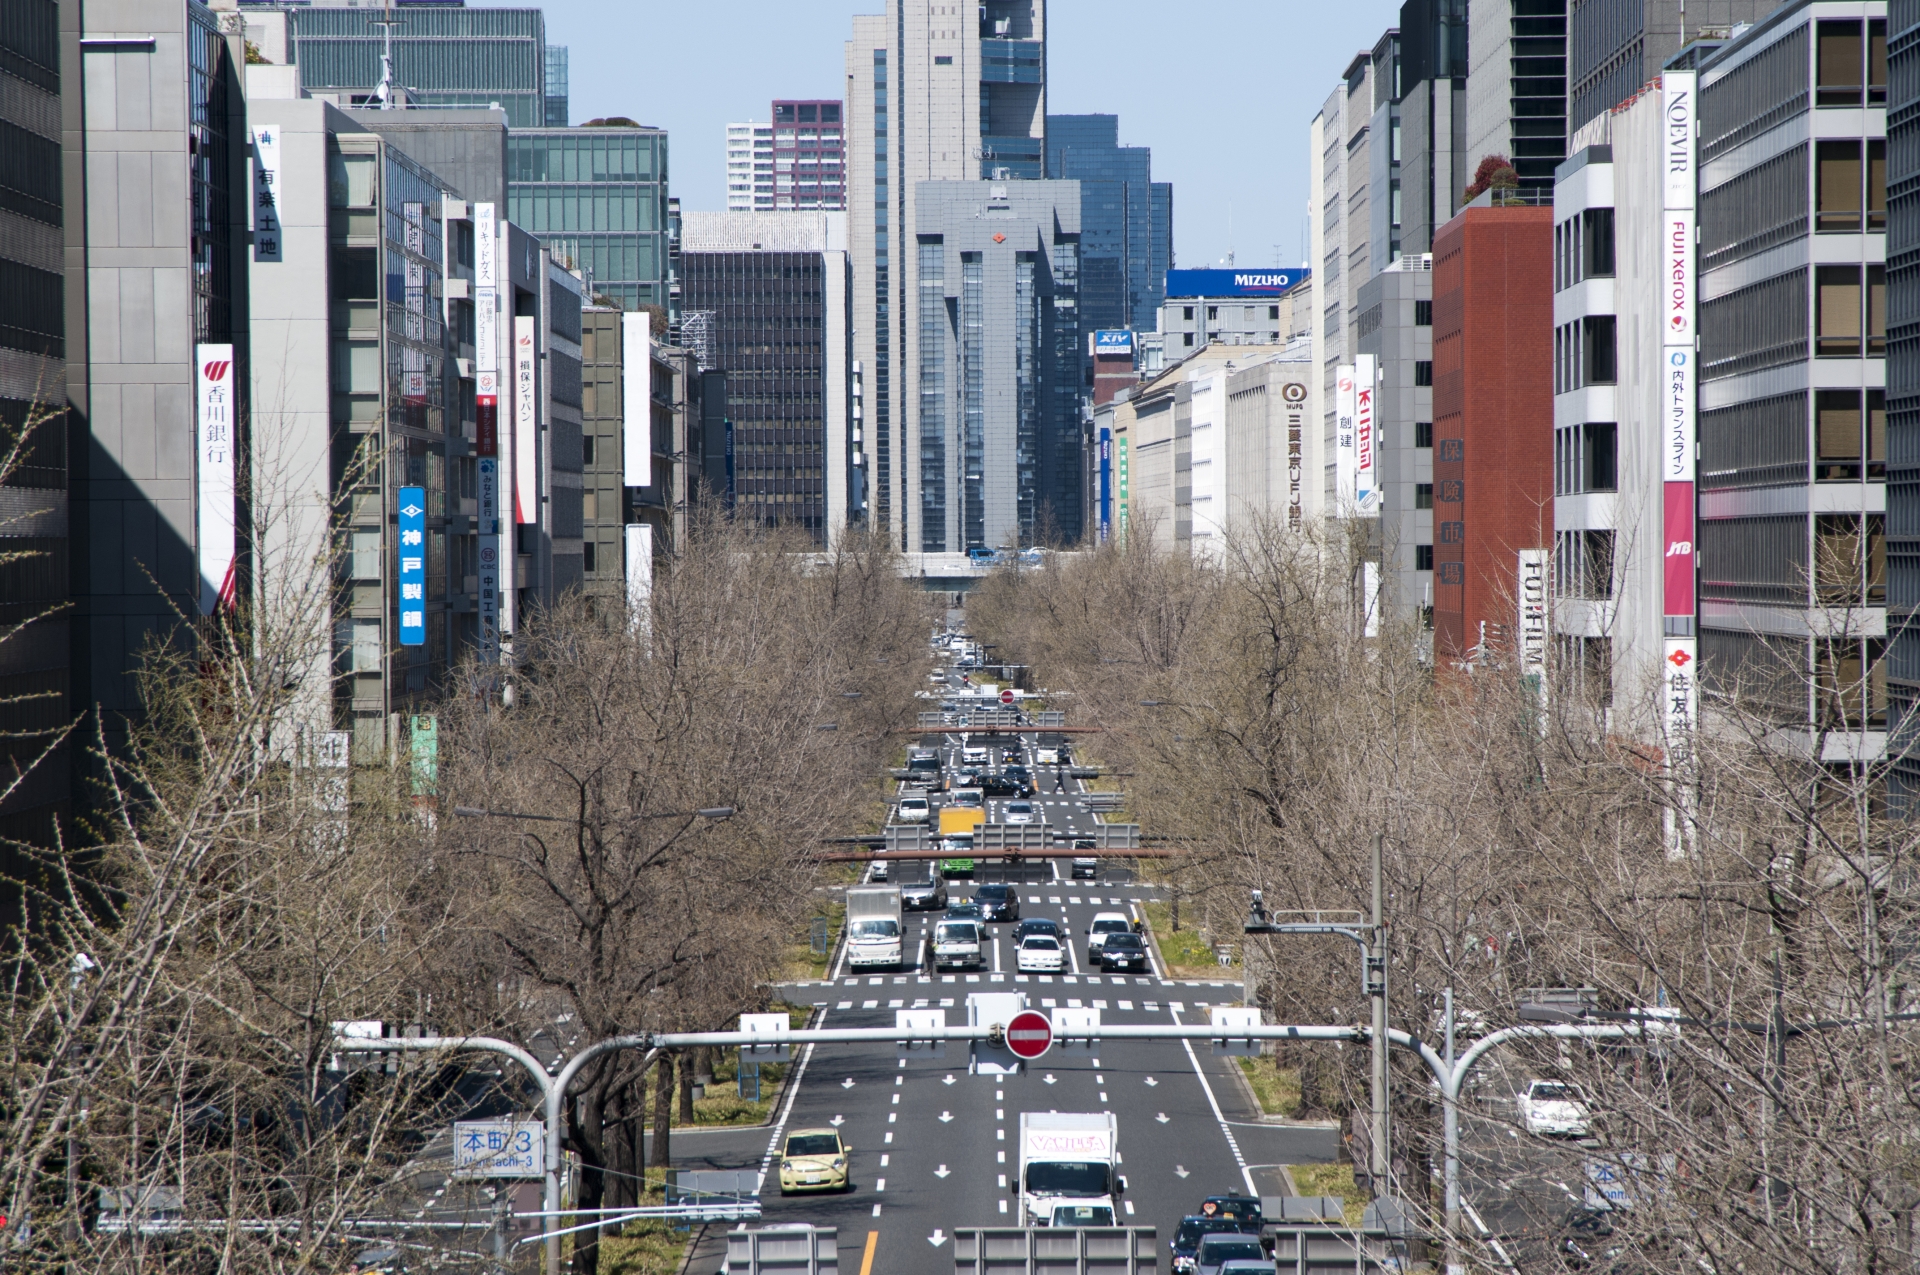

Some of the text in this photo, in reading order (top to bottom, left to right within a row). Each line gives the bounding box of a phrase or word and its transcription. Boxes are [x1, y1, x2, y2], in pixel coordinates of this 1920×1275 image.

[1667, 90, 1689, 175] NOEVIR
[258, 168, 277, 255] 有楽土地
[480, 222, 491, 280] リキッドガス
[1234, 274, 1289, 286] MIZUHO
[1672, 221, 1685, 310] FUJI xerox
[1099, 334, 1129, 343] XIV
[205, 385, 227, 463] 香川銀行
[519, 360, 532, 422] 損保ジャパン
[1672, 369, 1686, 475] 内外トランスライン
[1339, 416, 1353, 448] 創建
[482, 475, 492, 517] みなと銀行
[1288, 414, 1302, 533] 三菱東京UFJ銀行
[1443, 440, 1461, 584] 保険市場
[401, 529, 423, 628] 神戸製鋼
[1665, 541, 1692, 557] JTB
[1525, 562, 1543, 665] FUJIFILM
[463, 1155, 533, 1168] Hnachi-3
[1029, 1135, 1106, 1151] VANILLA
